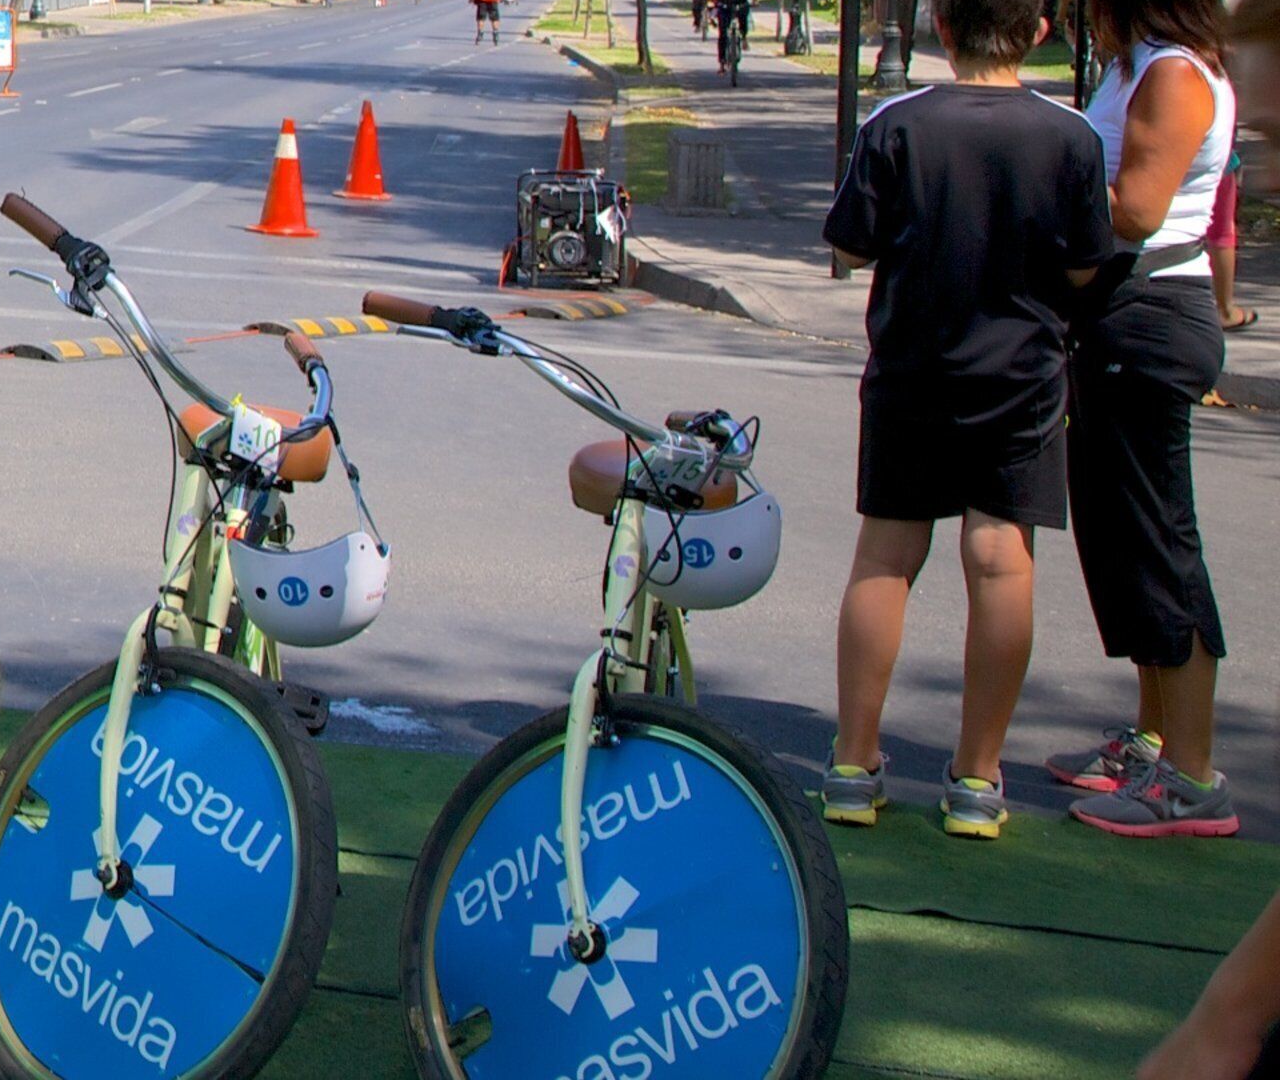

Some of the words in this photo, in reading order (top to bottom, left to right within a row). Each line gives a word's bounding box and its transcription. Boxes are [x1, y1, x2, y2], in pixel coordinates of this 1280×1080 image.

[252, 423, 277, 453] 10
[683, 545, 714, 563] 15
[279, 582, 307, 602] 10
